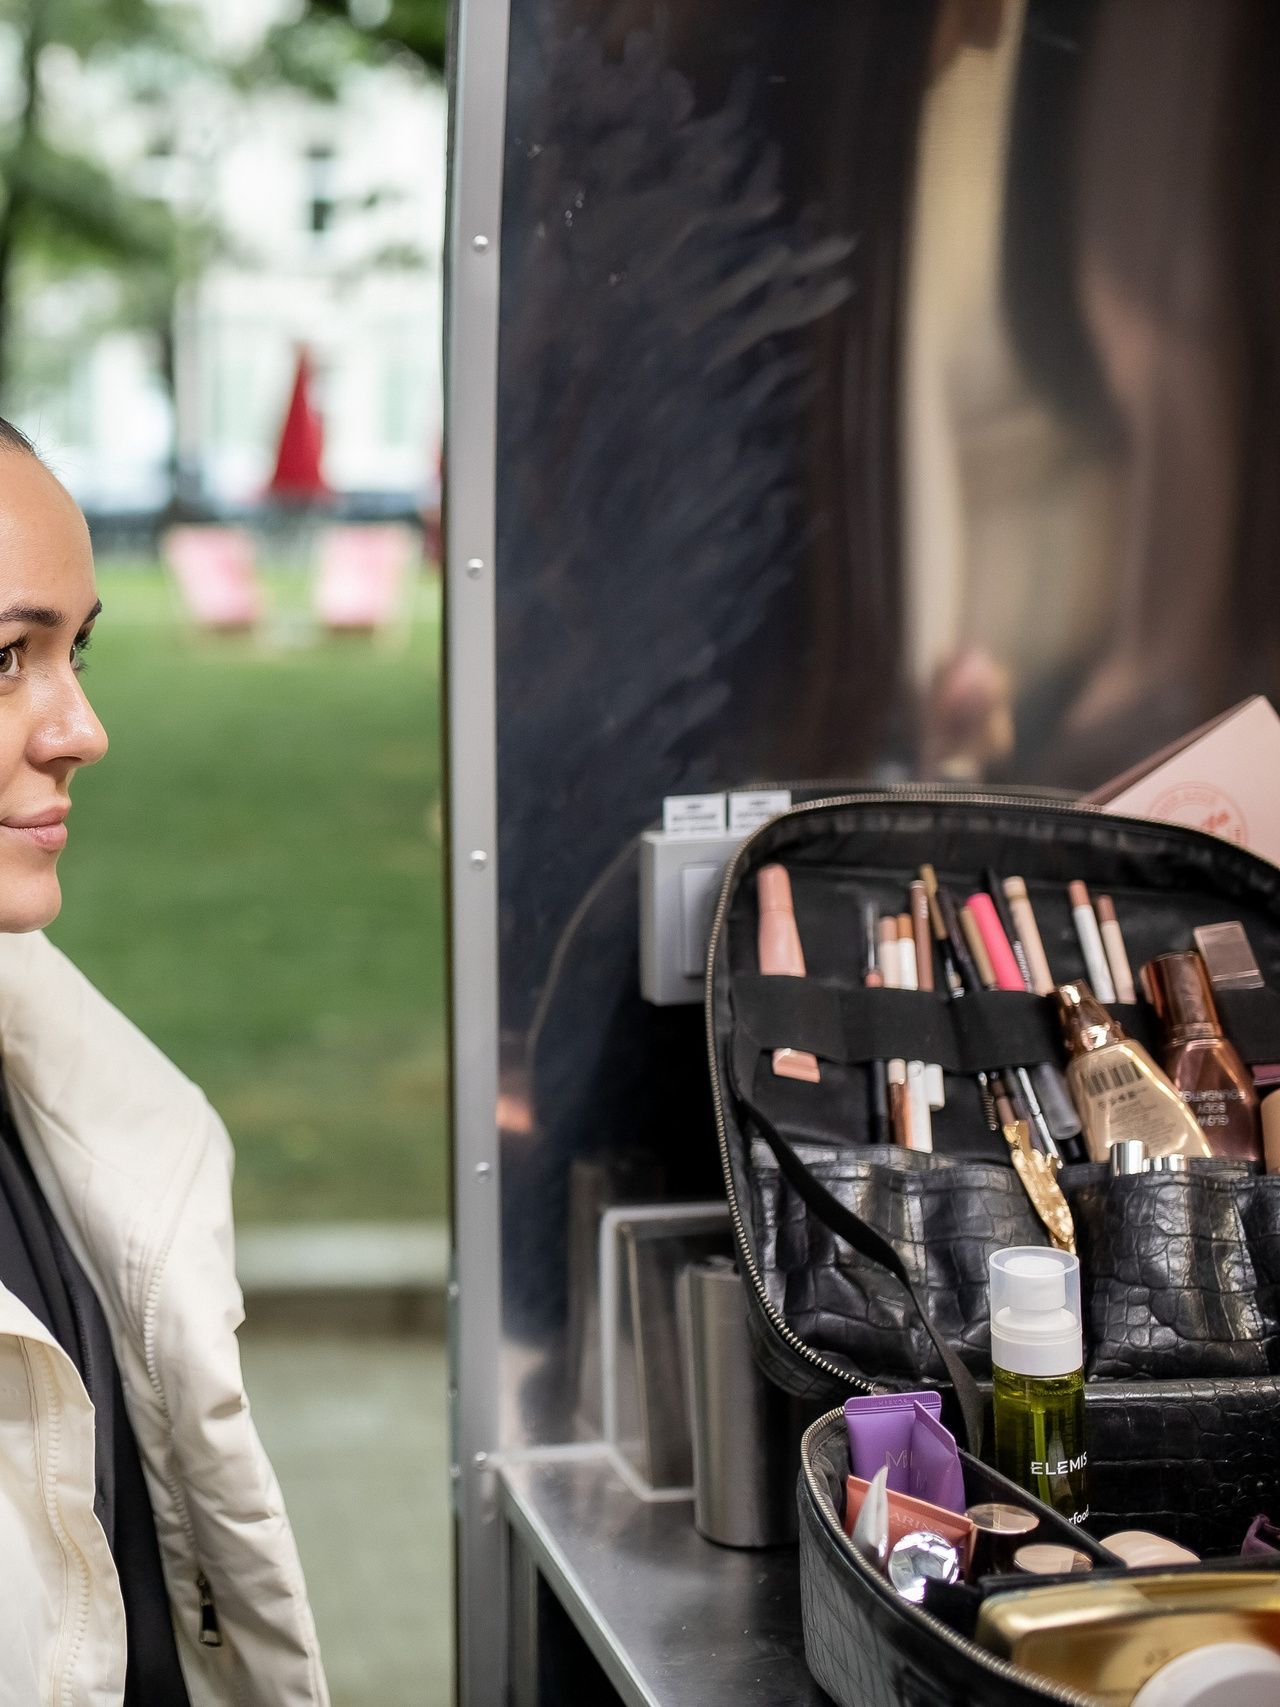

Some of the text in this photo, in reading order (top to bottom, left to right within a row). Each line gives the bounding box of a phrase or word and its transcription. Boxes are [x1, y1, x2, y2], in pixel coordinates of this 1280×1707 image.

[1181, 1089, 1247, 1103] FOUNDATIO
[1030, 1451, 1088, 1476] ELEMIS
[888, 1512, 945, 1538] ARINS
[1068, 1503, 1090, 1525] rfood
